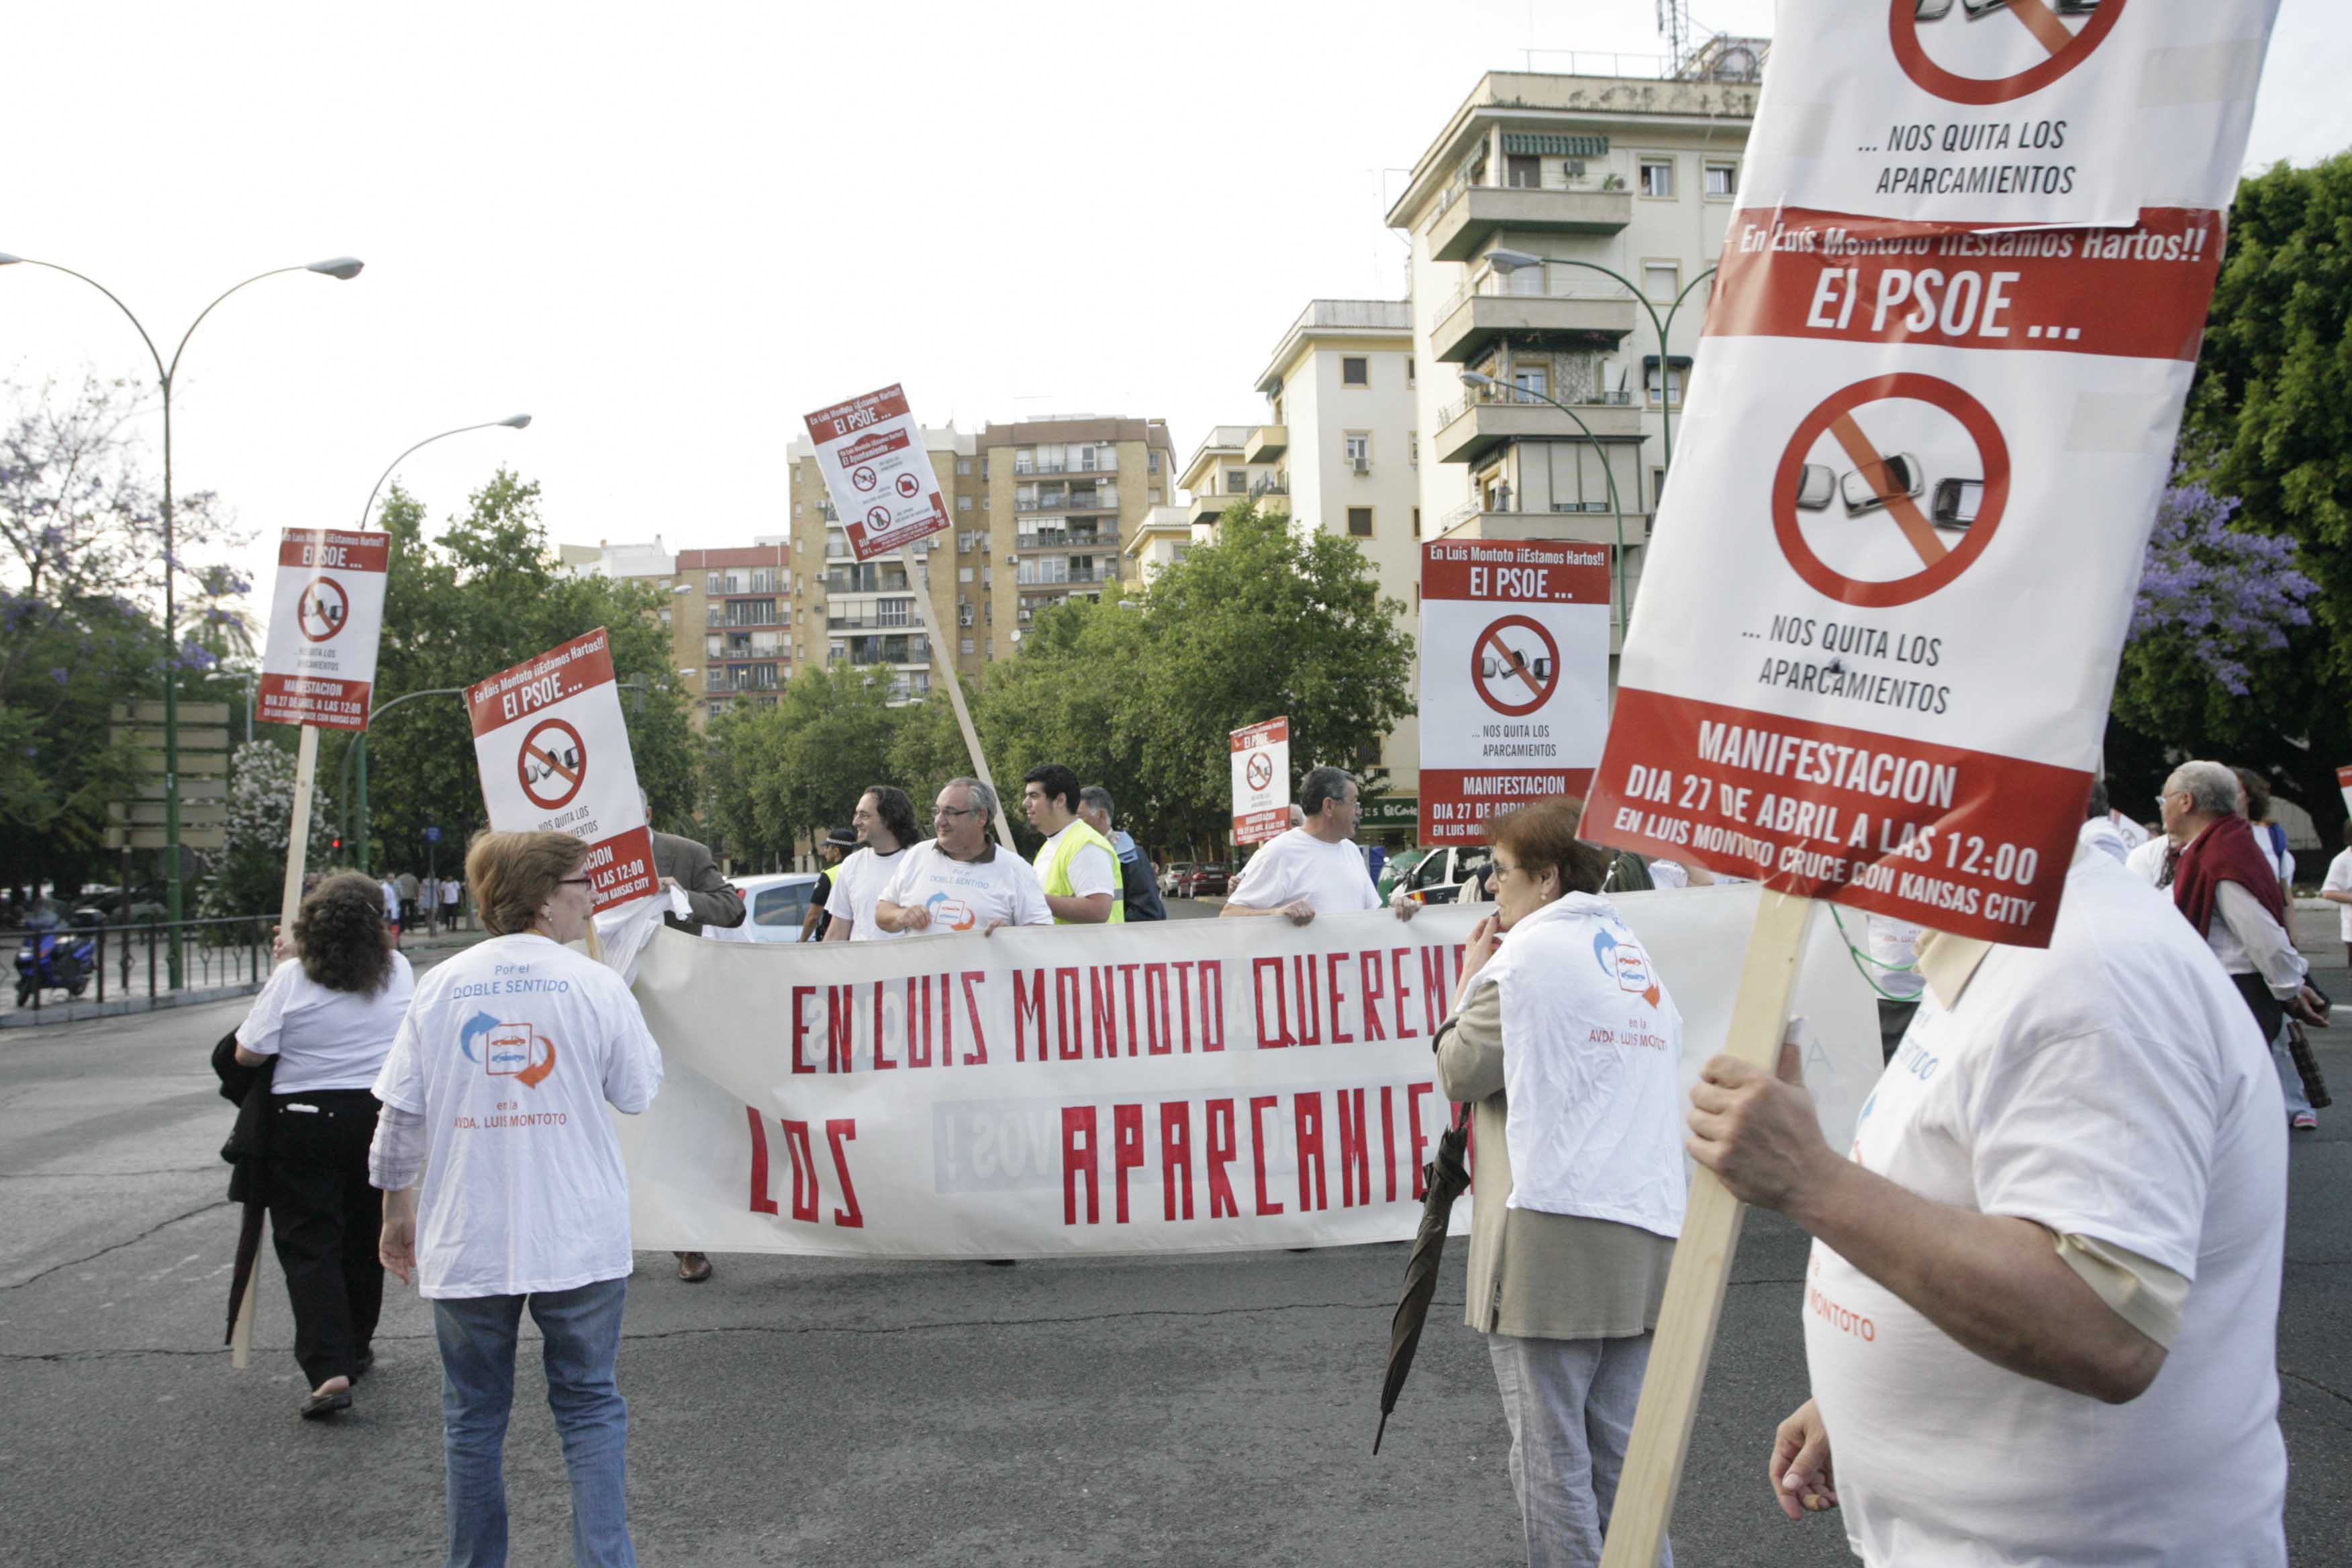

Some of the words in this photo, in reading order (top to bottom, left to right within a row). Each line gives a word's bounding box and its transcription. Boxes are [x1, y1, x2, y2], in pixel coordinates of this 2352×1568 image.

[1888, 124, 1937, 154] NOS
[1942, 121, 2010, 154] QUITA
[2018, 119, 2068, 150] LOS
[1876, 164, 2076, 196] APARCAMIENTOS
[1740, 224, 1767, 253] En
[1771, 222, 1818, 253] Luis
[1806, 267, 1859, 330] El
[1871, 268, 2021, 337] PSOE
[833, 419, 847, 435] El
[847, 407, 878, 430] PSOE
[313, 546, 348, 568] SOE
[1430, 545, 1444, 561] En
[1446, 546, 1469, 561] Luis
[1471, 547, 1514, 563] Montoto
[1567, 550, 1605, 567] Hartos!!
[1470, 567, 1489, 597] El
[1496, 568, 1549, 599] PSOE
[1769, 614, 1816, 648] NOS
[1821, 622, 1891, 661] QUITA
[1896, 632, 1943, 668] LOS
[283, 679, 344, 697] MANSTACION
[483, 683, 500, 699] Luis
[500, 669, 534, 691] Montoto
[502, 691, 519, 720] El
[521, 672, 564, 712] PSOE
[1758, 656, 1951, 716] APARCAMIENTOS
[324, 700, 339, 712] LAS
[1483, 724, 1502, 738] NOS
[1503, 724, 1530, 739] QUITA
[1533, 724, 1550, 738] LOS
[1483, 743, 1557, 757] APARCAMIENTOS
[1698, 720, 1958, 810] MANIFESTACION
[1463, 776, 1565, 795] MANIFESTACION
[554, 811, 575, 828] QUITA
[575, 805, 590, 820] LOS
[1433, 803, 1454, 820] DIA
[1457, 803, 1471, 819] 27
[1475, 803, 1491, 819] DE
[1625, 763, 1672, 804] DIA
[1679, 774, 1713, 812] 27
[1719, 783, 1753, 823] DE
[1755, 793, 1841, 844] ABRIL
[1847, 812, 1869, 849] A
[1879, 818, 1937, 863] LAS
[1945, 832, 2039, 886] 12:00
[1433, 824, 1444, 836] EN
[1446, 824, 1465, 836] LUIS
[597, 869, 616, 889] LAS
[616, 859, 645, 881] 12:00
[1614, 806, 1643, 832] EN
[1644, 812, 1692, 847] LUIS
[1692, 823, 1774, 867] MONTOTO
[1779, 846, 1847, 883] CRUCE
[1851, 861, 1896, 891] CON
[1898, 872, 1981, 914] KANSAS
[1983, 889, 2037, 928] CITY
[609, 881, 634, 900] KANSAS
[634, 877, 650, 891] CITY
[495, 965, 516, 975] Por
[519, 963, 530, 974] el
[453, 981, 500, 999] DOBLE
[505, 979, 569, 993] SENTIDO
[792, 983, 853, 1075] EN
[874, 971, 988, 1071] LUIS
[1012, 959, 1225, 1063] MONTOTO
[1621, 1031, 1638, 1046] LUIS
[509, 1113, 567, 1127] MONTOTO
[746, 1105, 864, 1228] LOS
